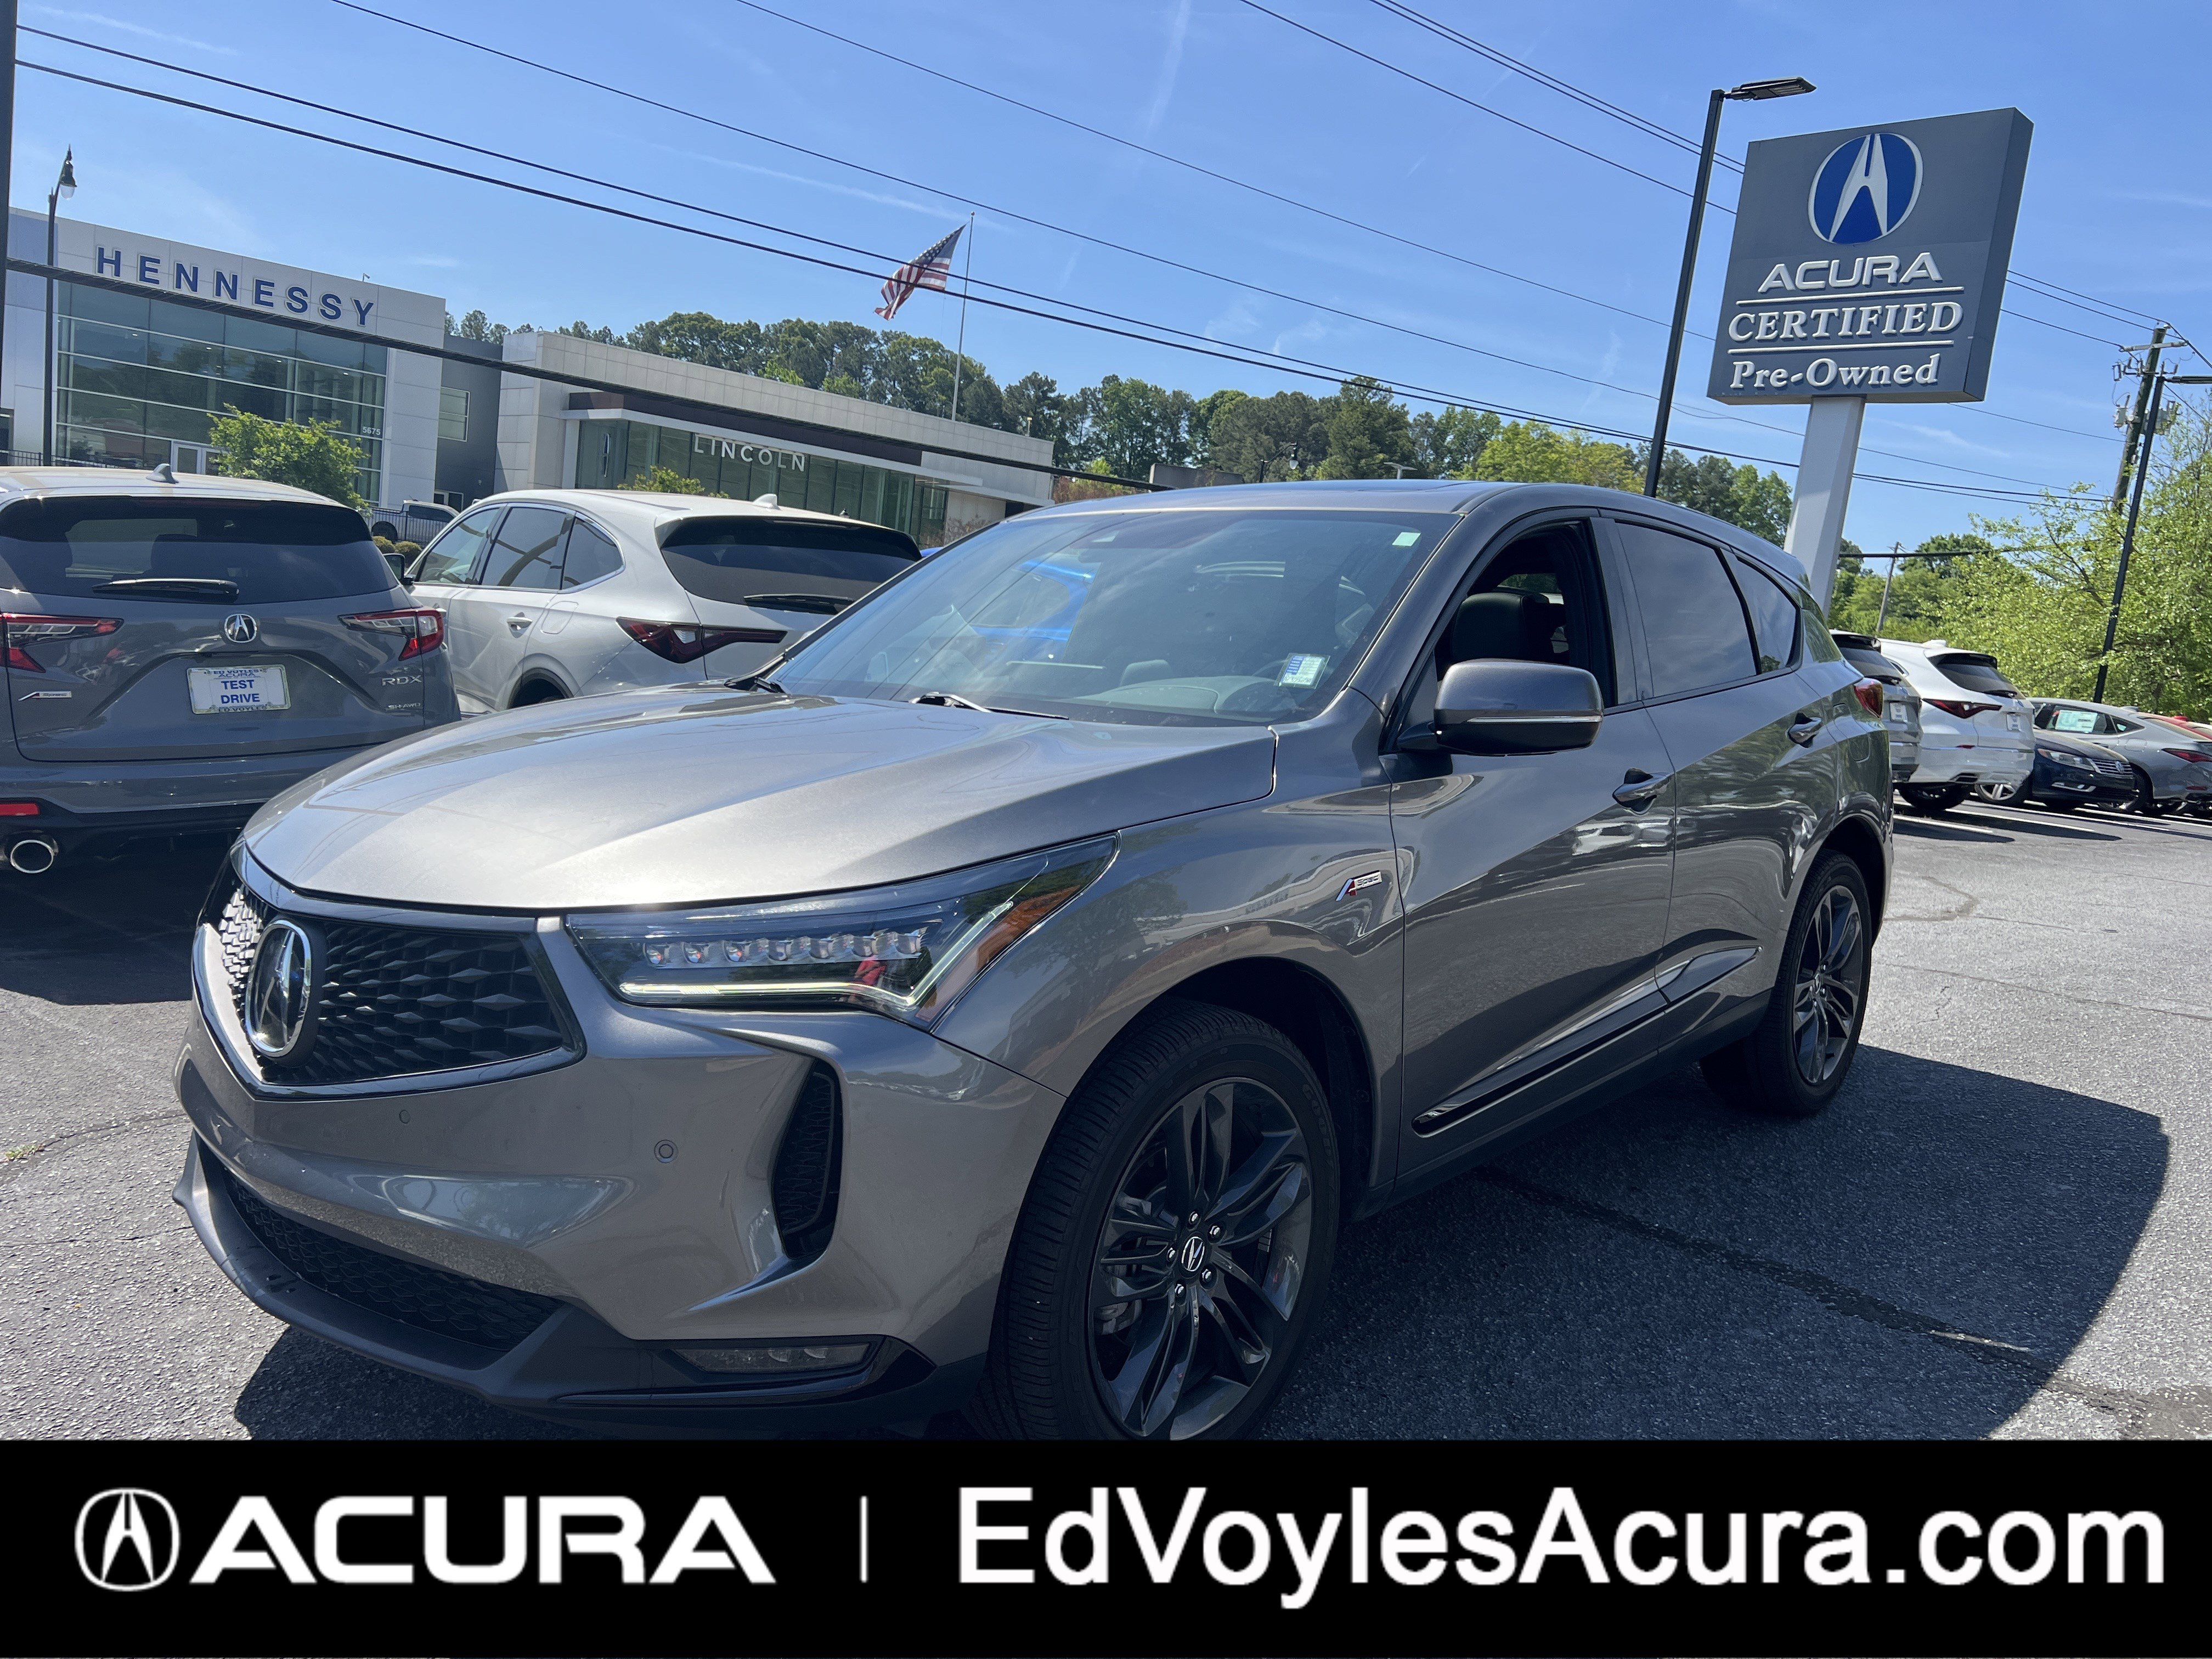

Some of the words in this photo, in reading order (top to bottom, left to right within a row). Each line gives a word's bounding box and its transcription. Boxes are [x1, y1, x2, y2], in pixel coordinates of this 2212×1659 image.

[95, 246, 375, 326] HENNESSY
[1757, 251, 1943, 294] ACURA
[1728, 301, 1964, 342] CERTIFIED
[1729, 353, 1941, 389] Pre-Owned
[362, 426, 381, 436] 5675
[694, 434, 805, 472] LINCOLN
[220, 693, 261, 704] DRIVE
[221, 679, 255, 691] TEST
[382, 675, 423, 686] RDX
